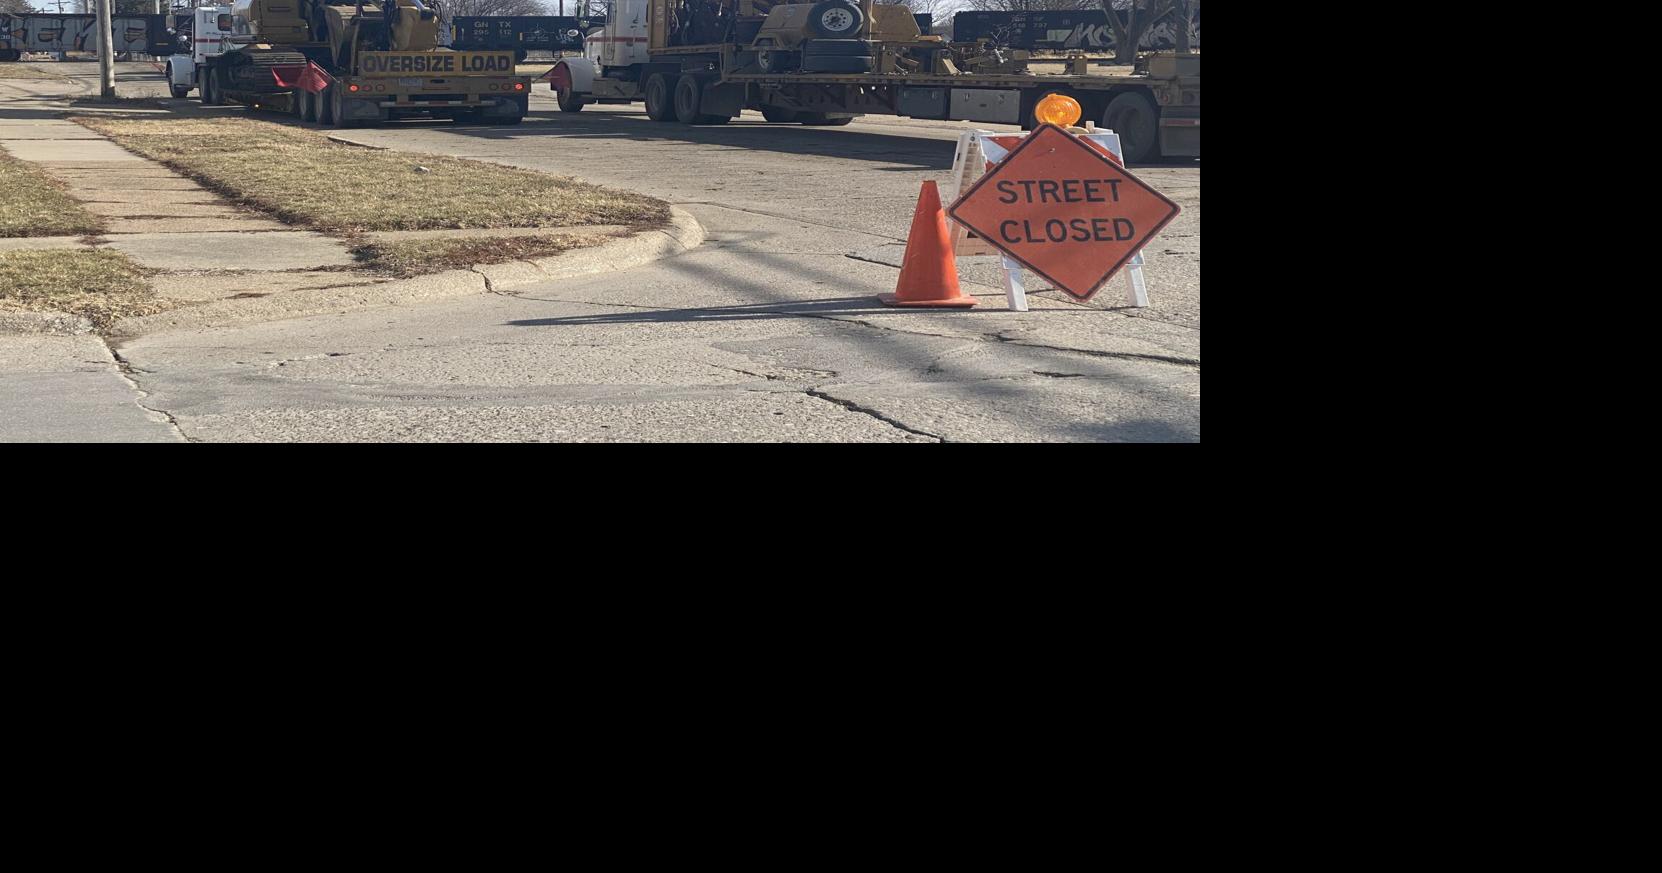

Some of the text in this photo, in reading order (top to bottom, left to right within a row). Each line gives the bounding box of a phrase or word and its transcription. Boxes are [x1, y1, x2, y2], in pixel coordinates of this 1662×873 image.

[363, 55, 511, 72] OVERSIZE LOAD
[996, 179, 1122, 204] STREET
[1000, 217, 1136, 244] CLOSED
